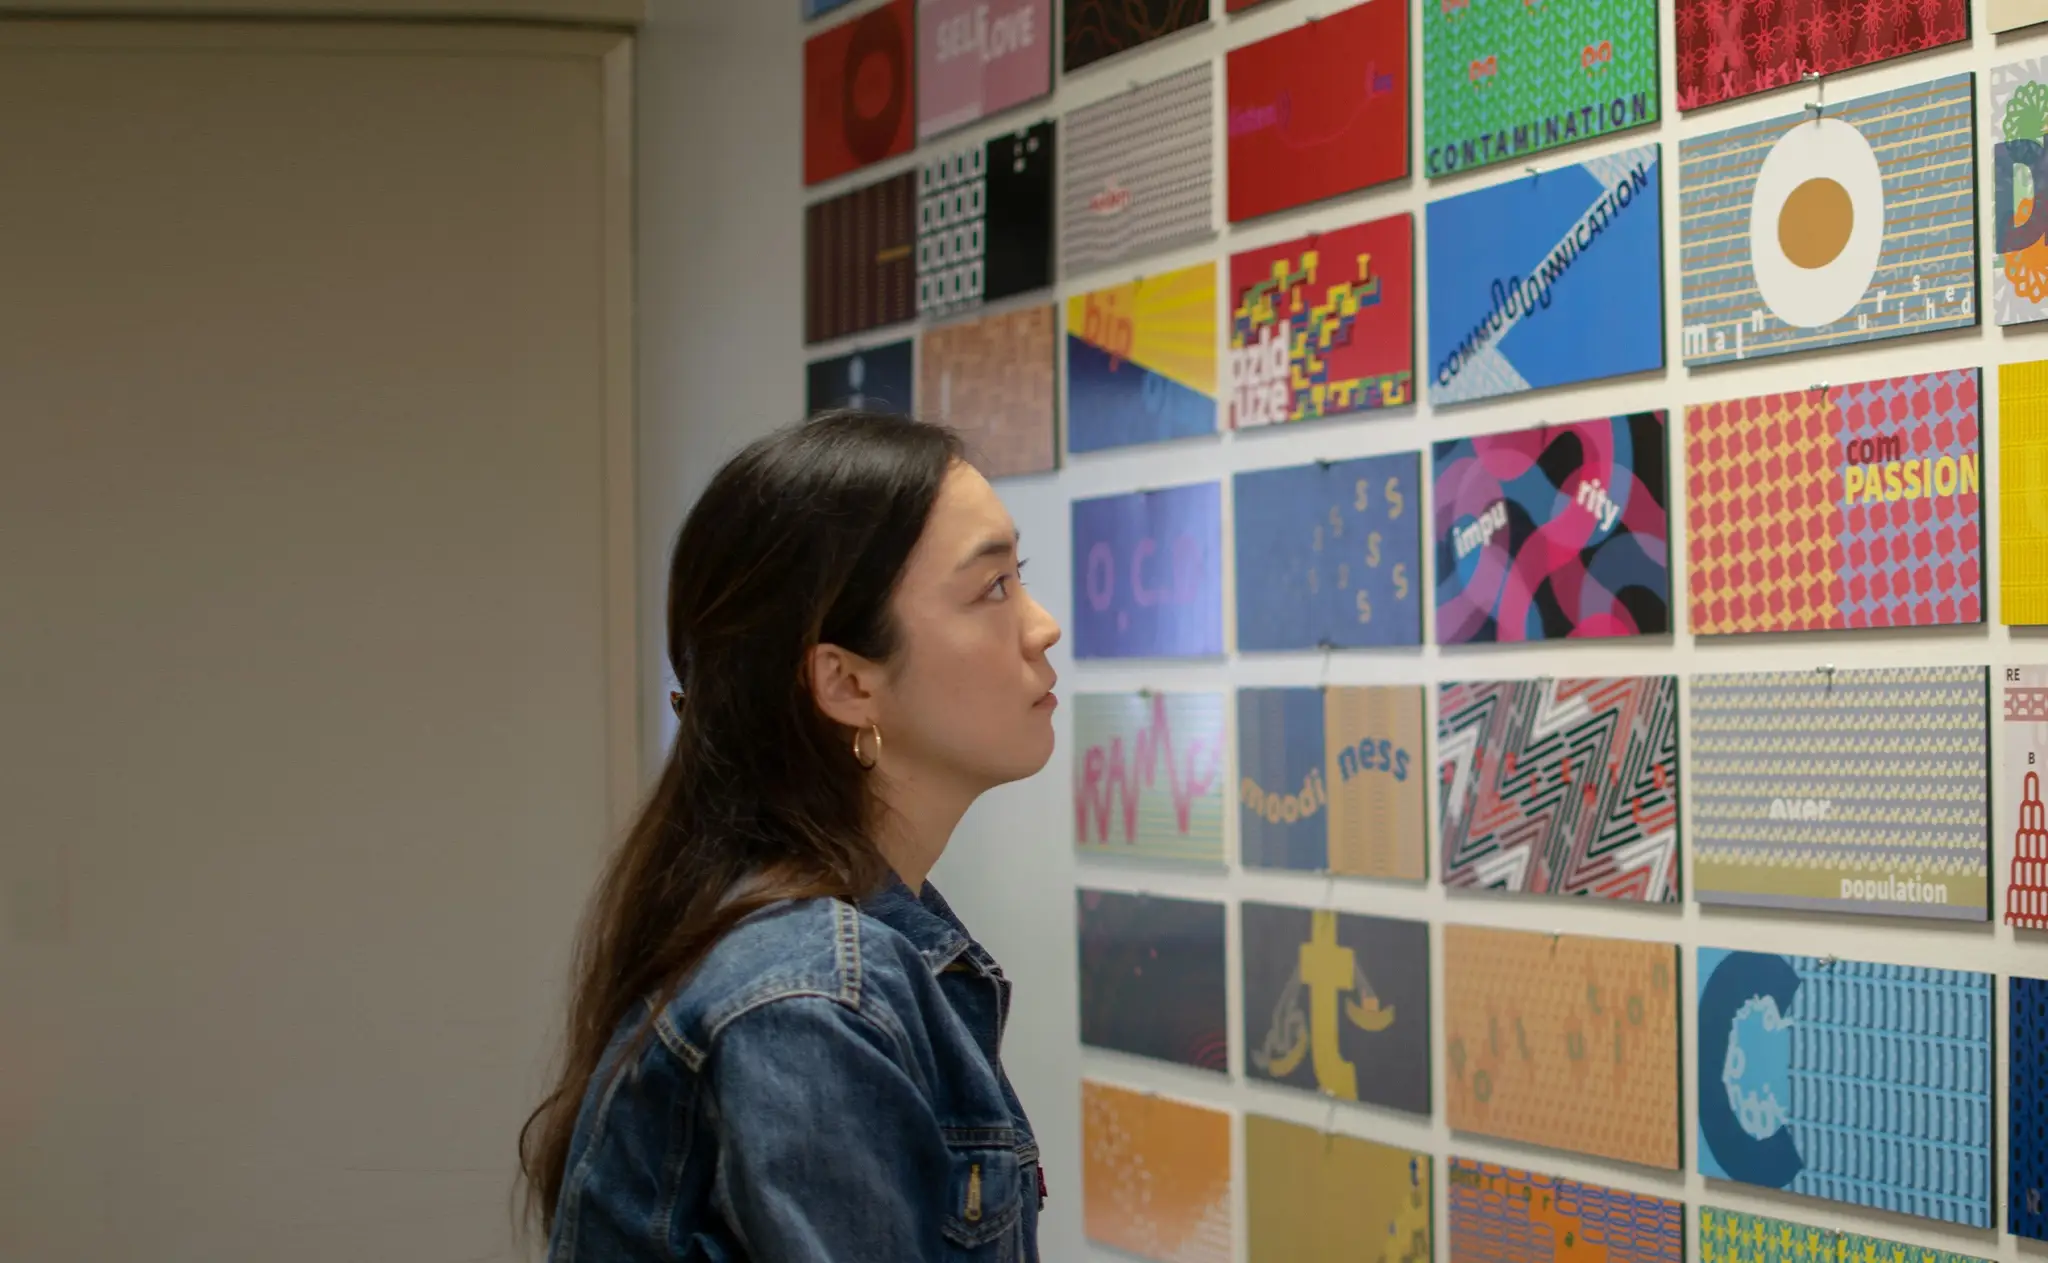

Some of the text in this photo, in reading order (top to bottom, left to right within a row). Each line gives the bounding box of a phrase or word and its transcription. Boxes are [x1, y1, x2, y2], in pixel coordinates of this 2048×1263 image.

[936, 4, 1035, 63] SELF LOVE
[1428, 91, 1647, 174] CONTAMINATION
[1846, 436, 1899, 466] com
[1577, 478, 1620, 532] rity
[1845, 453, 1979, 505] PASSION
[1453, 501, 1507, 559] impu
[2006, 668, 2021, 681] RE
[1338, 736, 1410, 782] ness
[1241, 768, 1325, 824] moodi
[1840, 873, 1948, 903] population
